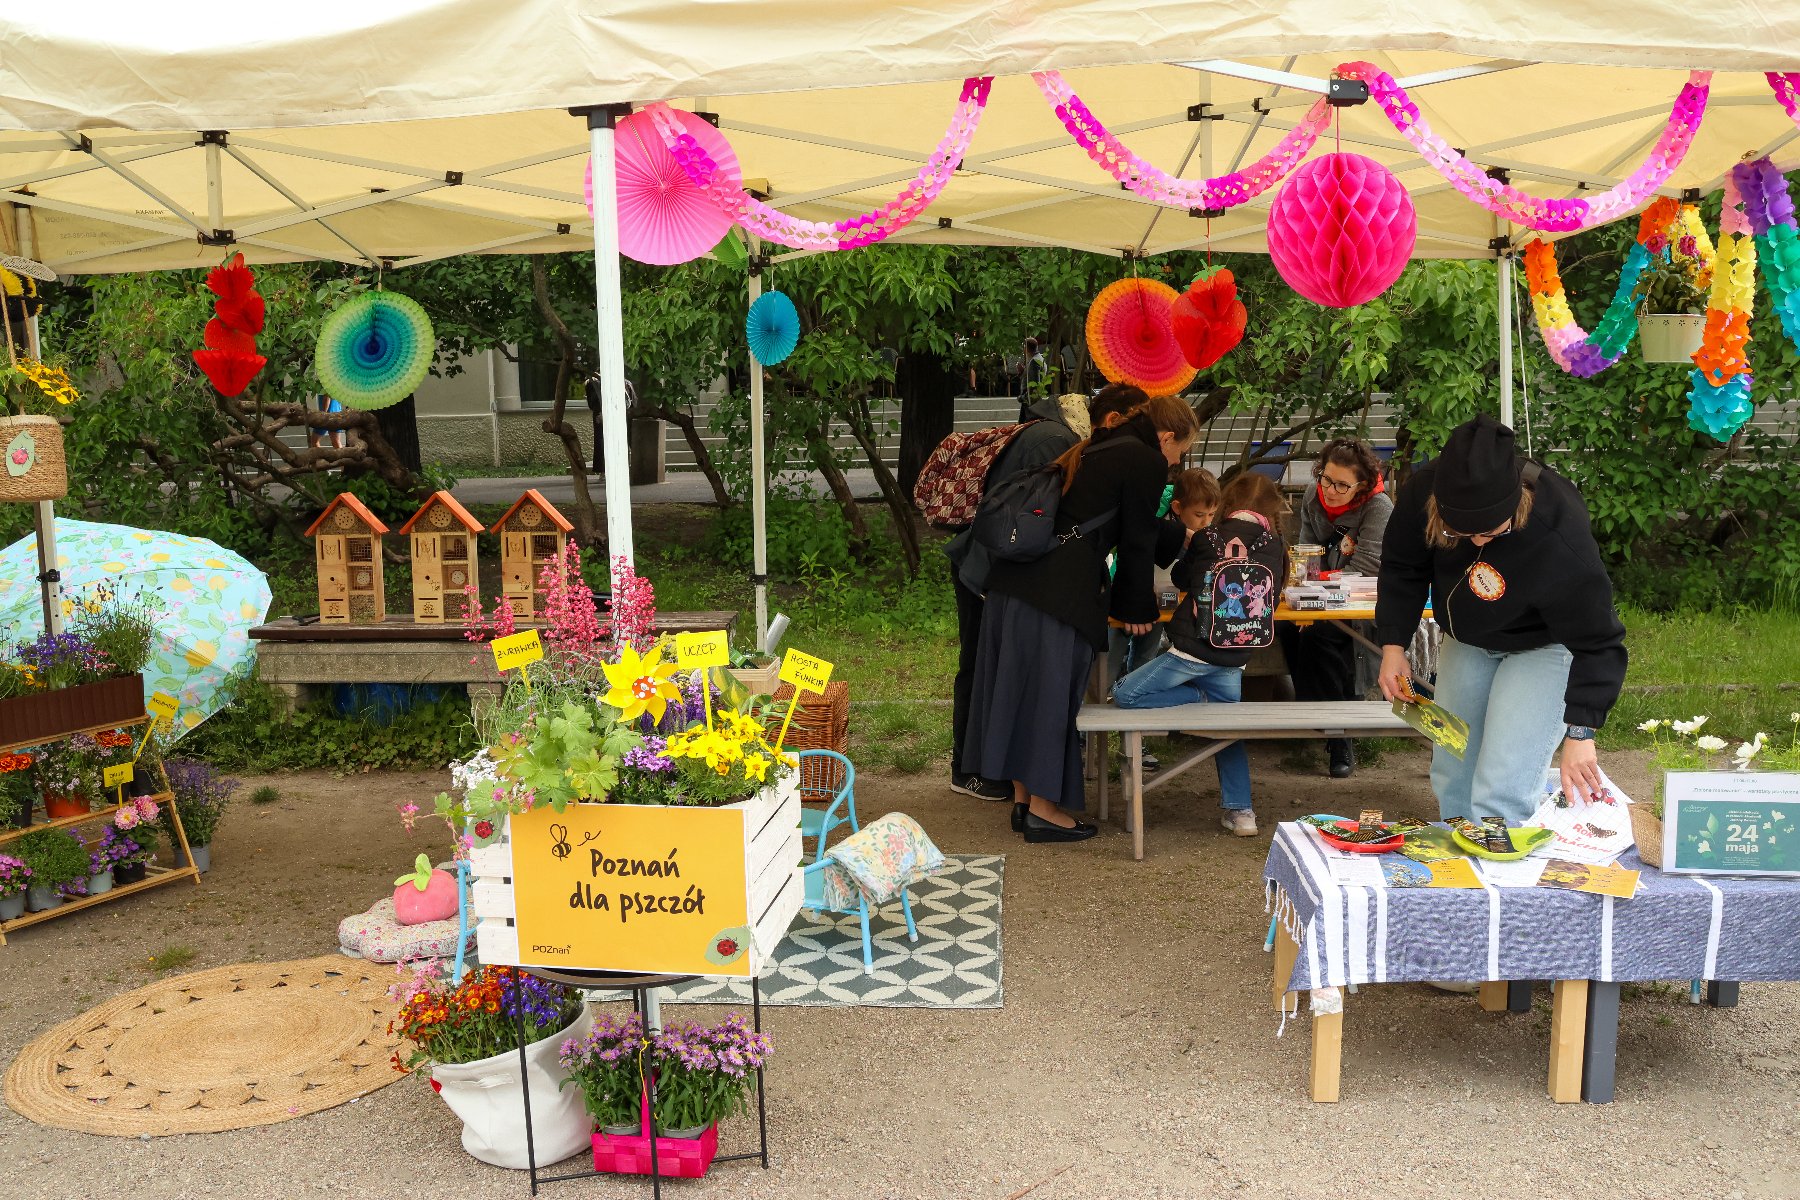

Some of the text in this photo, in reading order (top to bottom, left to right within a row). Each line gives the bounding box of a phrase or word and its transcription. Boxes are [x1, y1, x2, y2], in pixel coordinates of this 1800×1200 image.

[1225, 620, 1262, 633] TROPICAL
[1726, 823, 1759, 842] 24
[1725, 841, 1759, 855] maja
[590, 847, 681, 878] Poznań
[569, 881, 706, 923] dla pszczół
